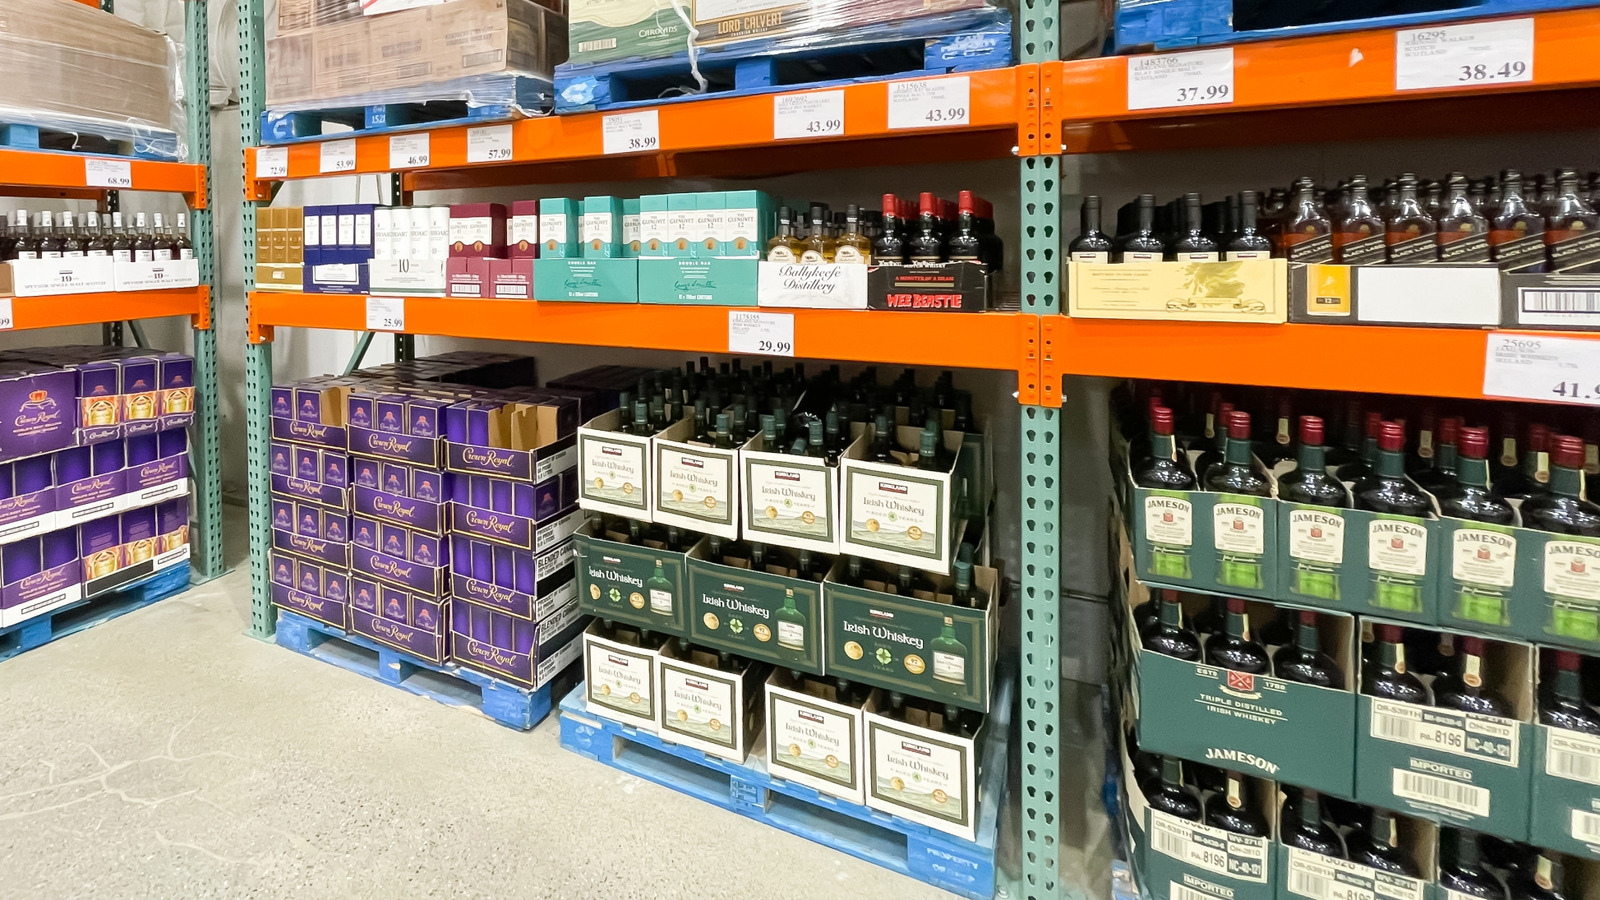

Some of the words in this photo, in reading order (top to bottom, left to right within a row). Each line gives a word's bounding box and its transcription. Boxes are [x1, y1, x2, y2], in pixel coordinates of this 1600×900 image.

[718, 18, 740, 35] LORD
[742, 12, 783, 31] CALVERT
[1412, 30, 1446, 42] 16295
[1459, 61, 1526, 81] 38.49
[1177, 84, 1229, 102] 37.99
[926, 108, 966, 122] 43.99
[806, 120, 841, 132] 43.99
[629, 136, 656, 149] 38.99
[408, 155, 428, 166] 46.99
[488, 148, 511, 159] 57.99
[270, 166, 286, 175] 72.99
[336, 159, 354, 169] 53.99
[399, 259, 410, 273] 10
[778, 265, 844, 279] Ballykeefe
[784, 278, 837, 294] Distillery
[887, 294, 912, 308] WEE
[913, 294, 962, 309] BEASTIE
[384, 318, 403, 328] 25.99
[759, 340, 791, 353] 29.99
[1503, 339, 1541, 350] 25695
[15, 415, 37, 427] Crown
[35, 410, 61, 424] Royal
[290, 422, 308, 435] Crown
[306, 423, 328, 438] Royal
[369, 434, 388, 448] Crown
[384, 438, 412, 452] Royal
[463, 447, 486, 464] Crown
[480, 450, 515, 468] Royal
[141, 467, 160, 478] Crown
[158, 460, 178, 474] Royal
[607, 461, 634, 475] Whiskey
[72, 483, 93, 495] Crown
[90, 476, 114, 490] Royal
[670, 470, 686, 480] Irish
[687, 474, 718, 488] Whiskey
[762, 486, 781, 496] Irish
[782, 487, 816, 502] Whiskey
[374, 496, 394, 511] Crown
[389, 500, 415, 517] Royal
[863, 497, 885, 507] Irish
[886, 500, 925, 516] Whiskey
[1147, 500, 1190, 513] JAMESON
[1216, 507, 1261, 520] JAMESON
[466, 510, 489, 526] Crown
[485, 515, 515, 534] Royal
[1293, 514, 1342, 528] JAMESON
[1372, 524, 1424, 539] JAMESON
[1457, 533, 1513, 549] JAMESON
[371, 555, 389, 570] Crown
[386, 560, 412, 579] Royal
[538, 550, 560, 568] BLENDED
[20, 578, 42, 590] Crown
[41, 568, 66, 583] Royal
[606, 571, 643, 588] Whiskey
[466, 579, 488, 595] Crown
[485, 585, 516, 603] Royal
[288, 590, 306, 603] Crown
[303, 595, 324, 612] Royal
[703, 594, 725, 608] Irish
[726, 599, 770, 620] Whiskey
[372, 618, 391, 633] Crown
[389, 623, 414, 642] Royal
[844, 620, 871, 636] Irish
[873, 626, 924, 650] Whiskey
[468, 640, 490, 656] Crown
[485, 647, 516, 666] Royal
[1265, 681, 1286, 691] 1780
[692, 695, 722, 711] Whiskey
[1200, 694, 1232, 706] TRIPLE
[1235, 700, 1283, 716] DISTILLED
[1207, 705, 1232, 716] IRISH
[1234, 711, 1276, 725] WHISKEY
[786, 723, 804, 734] Irish
[805, 728, 840, 746] Whiskey
[887, 754, 908, 766] Irish
[910, 760, 949, 780] Whiskey
[1205, 748, 1278, 774] JAMESON
[1410, 759, 1473, 780] IMPORTED
[1184, 875, 1234, 897] IMPORTED
